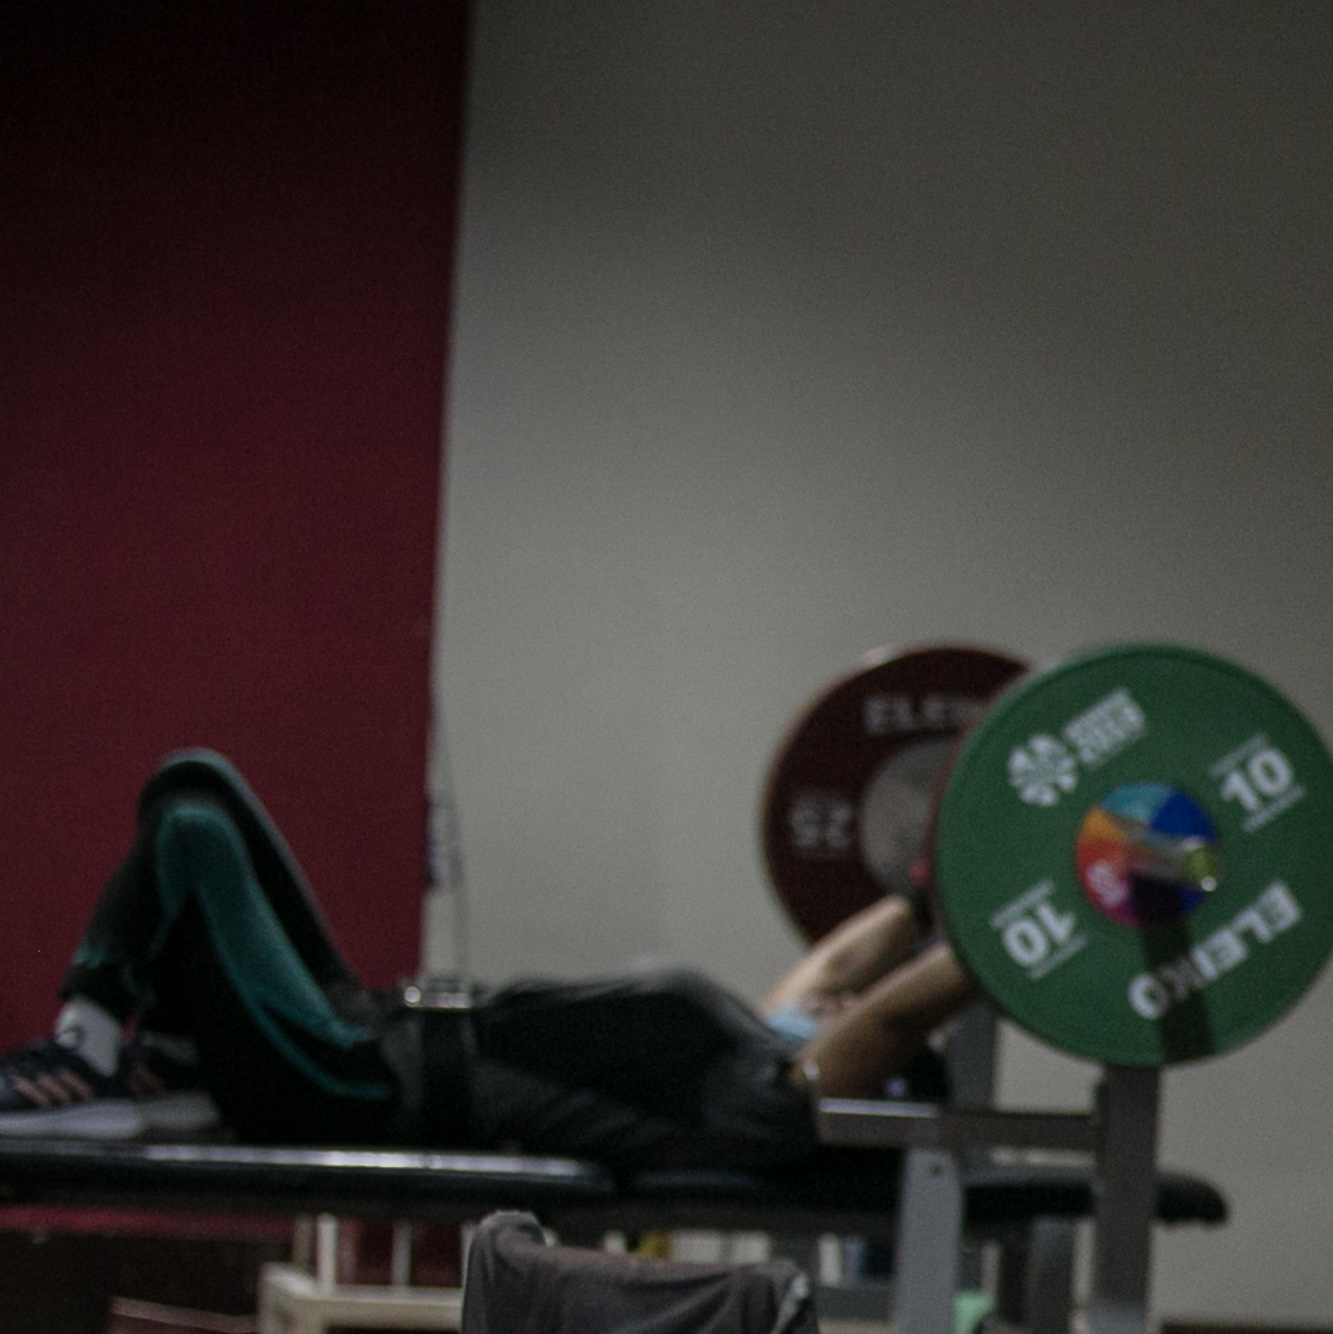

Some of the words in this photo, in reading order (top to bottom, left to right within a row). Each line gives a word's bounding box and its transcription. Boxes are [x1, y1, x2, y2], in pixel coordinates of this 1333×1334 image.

[1219, 745, 1295, 813] 10
[1002, 903, 1077, 967] 10
[1127, 882, 1301, 1020] ELEIKO
